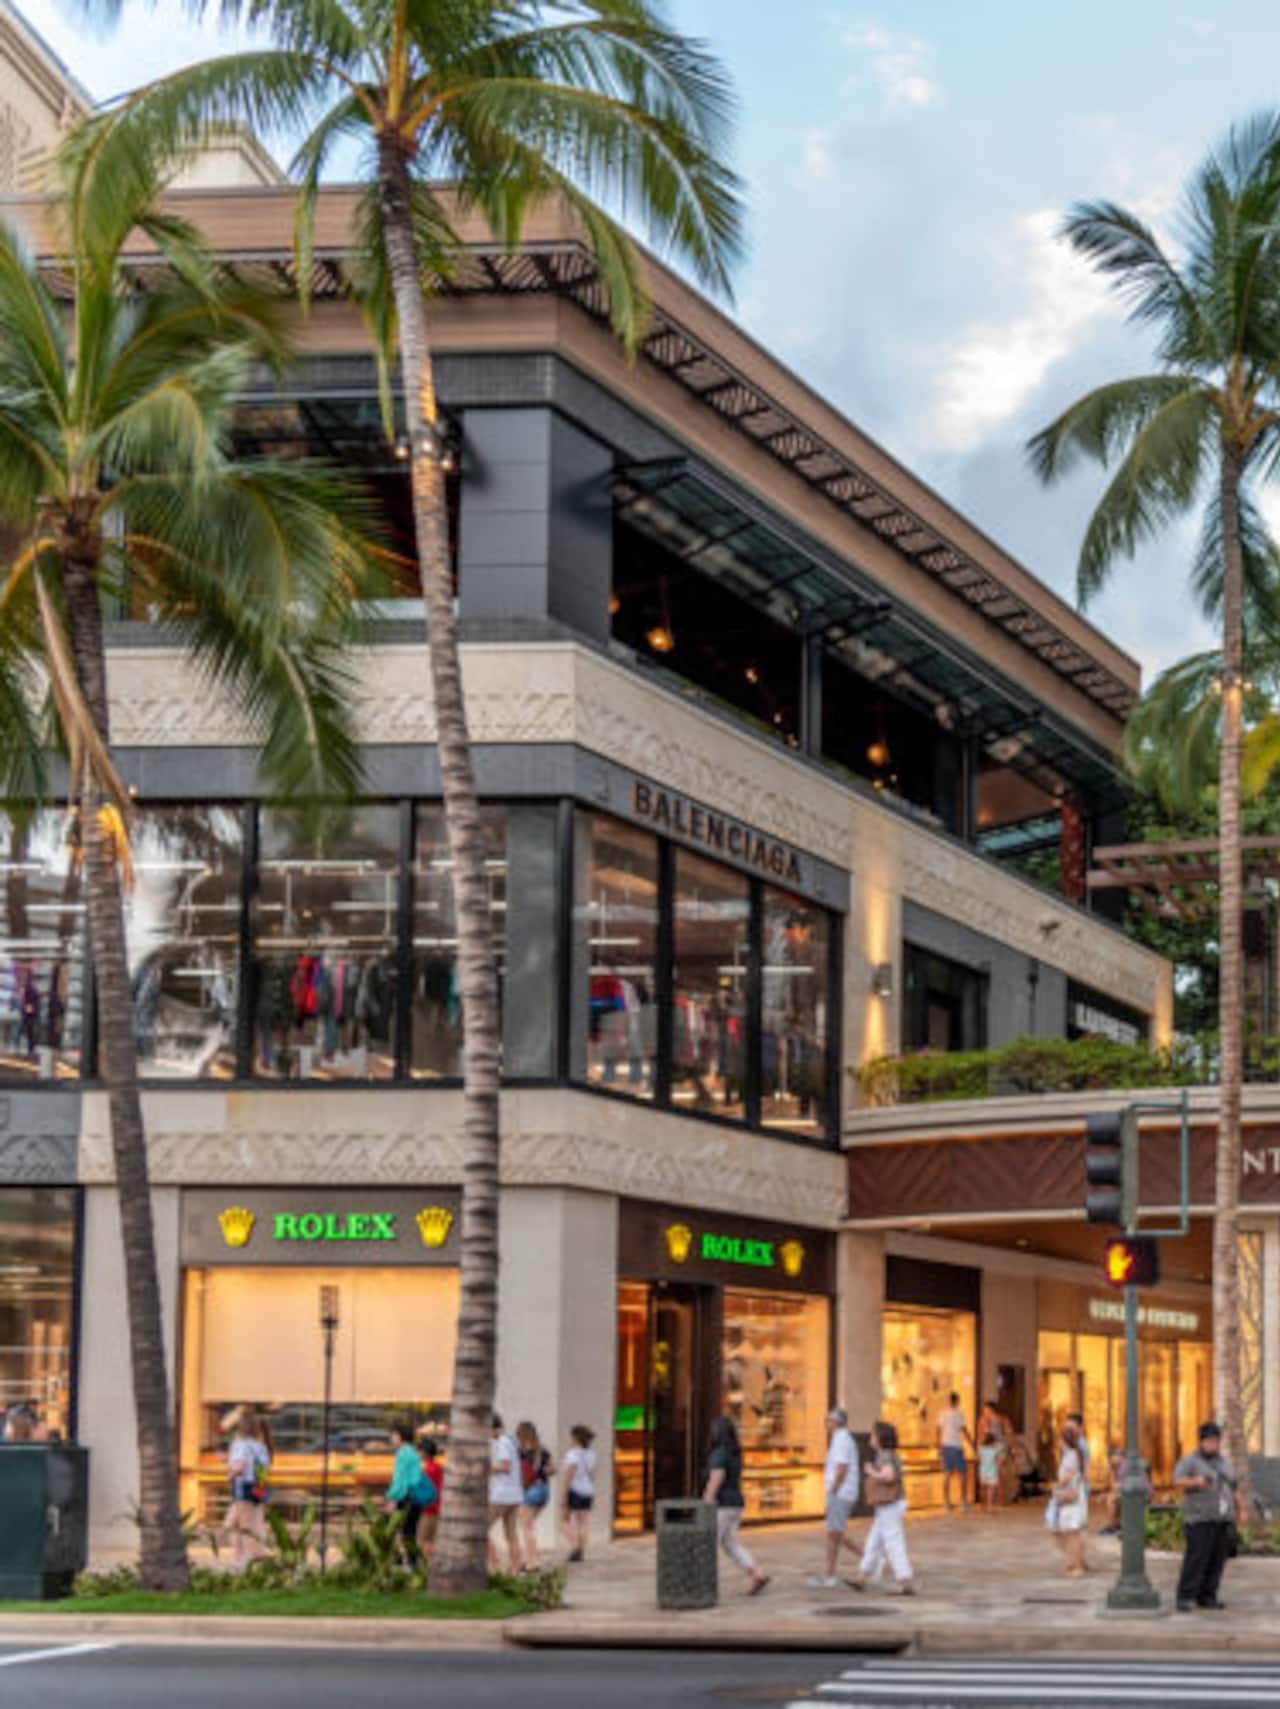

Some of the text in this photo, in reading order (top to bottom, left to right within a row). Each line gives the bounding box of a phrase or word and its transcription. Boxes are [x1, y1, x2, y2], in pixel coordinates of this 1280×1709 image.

[632, 781, 802, 882] BALENCIAGA
[272, 1211, 396, 1240] ROLEX
[701, 1232, 775, 1267] ROLEX
